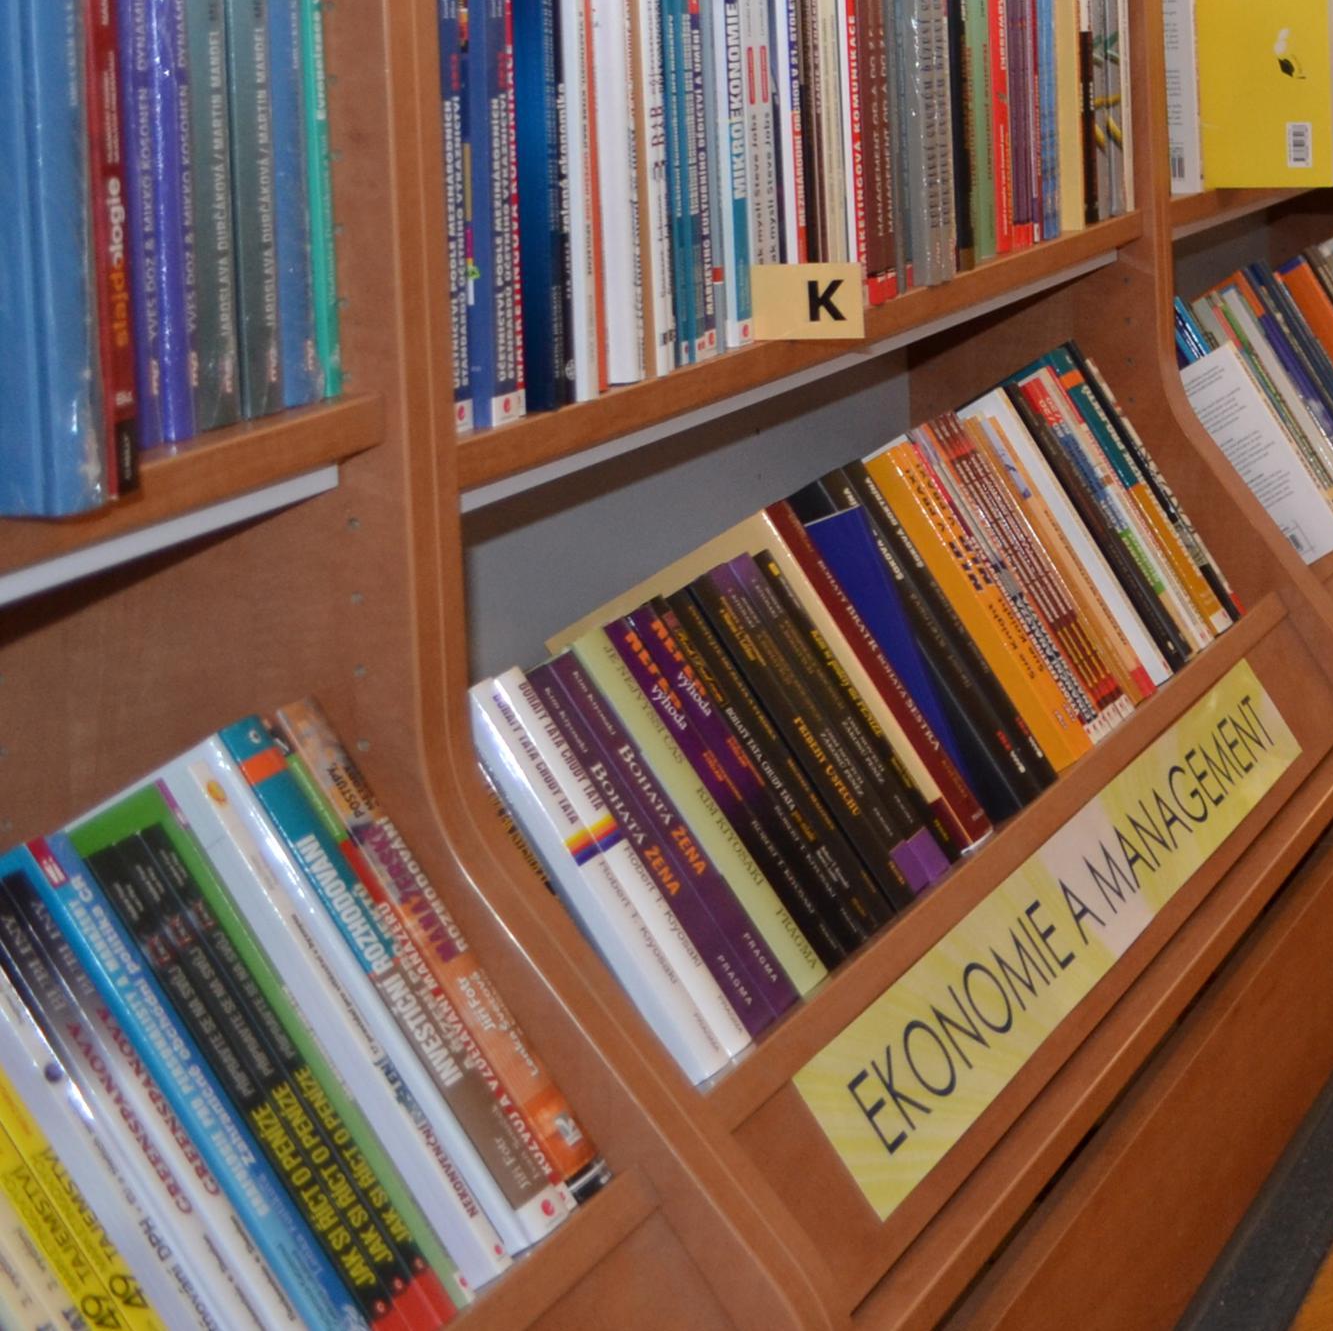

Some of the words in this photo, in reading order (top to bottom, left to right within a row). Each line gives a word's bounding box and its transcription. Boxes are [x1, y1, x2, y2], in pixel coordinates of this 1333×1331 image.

[726, 2, 748, 199] MIKROEKONOMIE
[105, 177, 132, 348] slajdologie
[808, 280, 847, 322] K
[288, 830, 398, 978] ROZHODOVÁNÍ
[642, 843, 684, 897] ŽENA
[715, 952, 754, 1007] PRAGMA
[669, 824, 711, 878] ŽENA
[741, 930, 779, 984] PRAGMA
[847, 899, 1076, 1155] EKONOMIE
[1058, 878, 1105, 945] A
[1083, 695, 1275, 915] MANAGEMENT
[376, 970, 466, 1089] INVESTIČNÍ
[245, 1100, 306, 1173] PENÍZE
[265, 1079, 325, 1151] PENÍZE
[295, 1180, 341, 1232] ŘÍCT
[325, 1222, 354, 1251] SI
[360, 1227, 396, 1268] JAK
[341, 1247, 378, 1290] JAK
